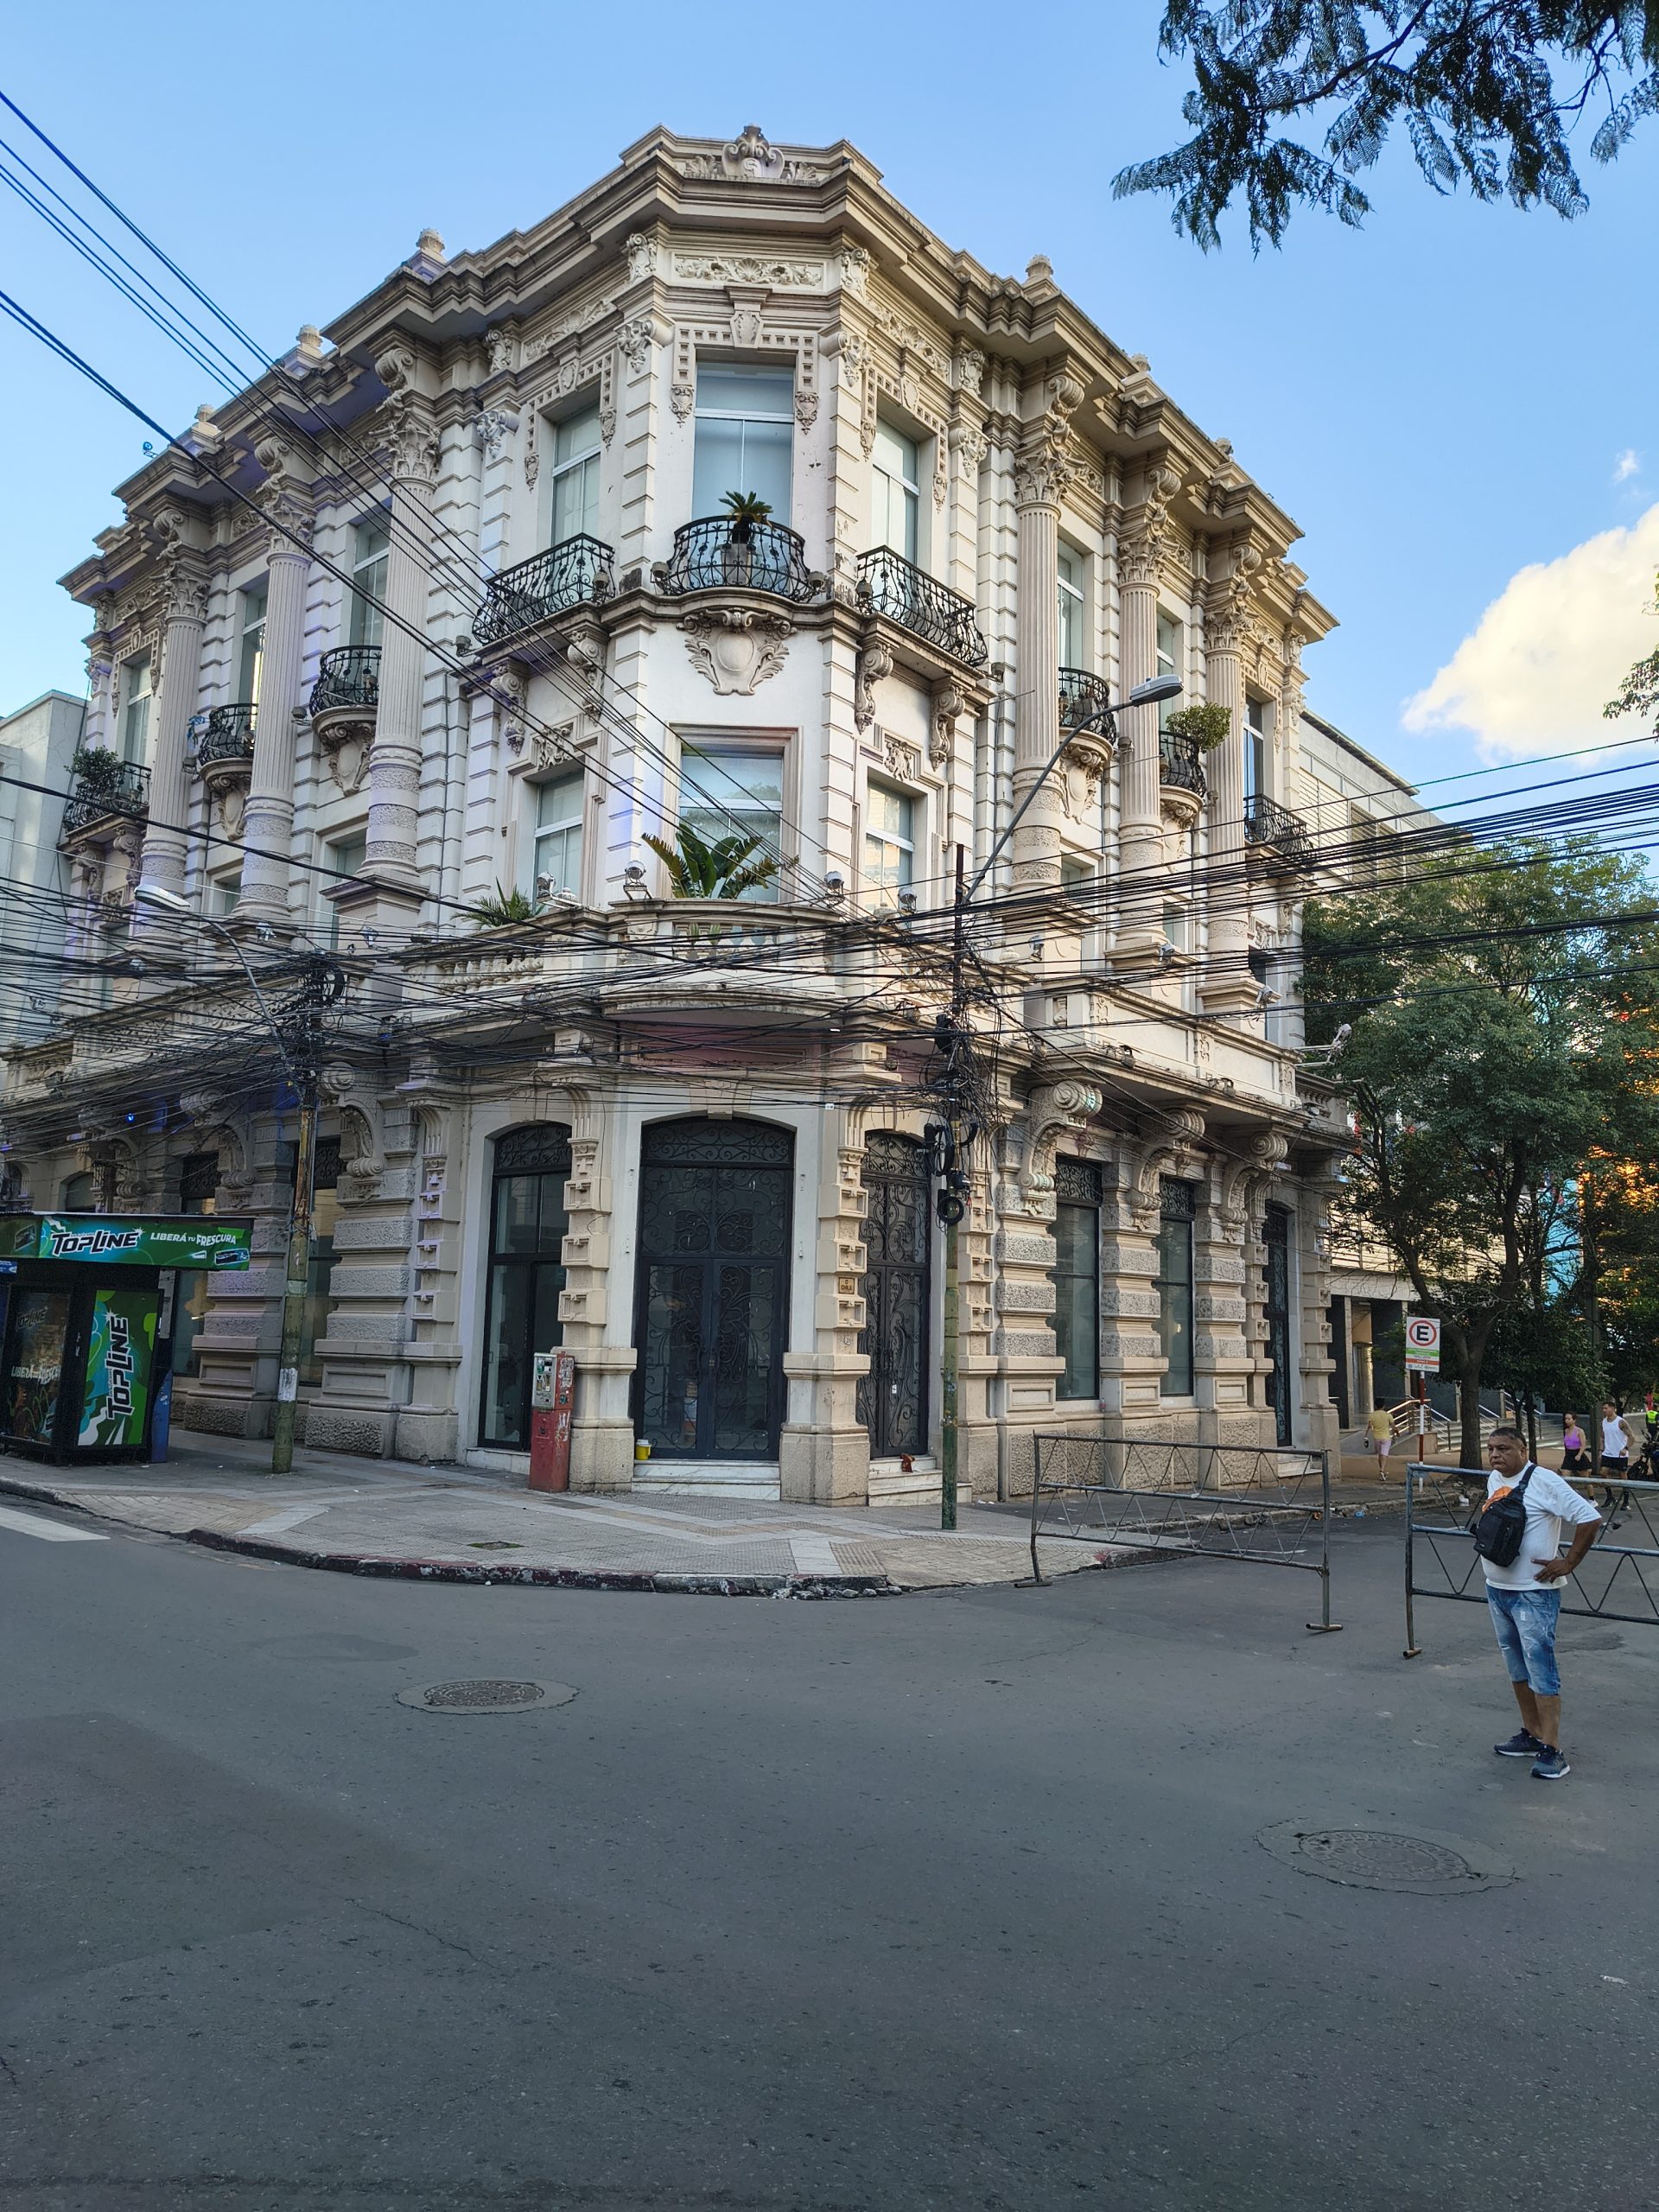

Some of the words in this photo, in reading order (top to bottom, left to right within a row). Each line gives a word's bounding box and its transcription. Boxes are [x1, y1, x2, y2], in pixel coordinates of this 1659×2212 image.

[150, 1232, 187, 1243] LIBERÁ
[196, 1234, 236, 1246] FRESCURA
[1416, 1325, 1429, 1341] E
